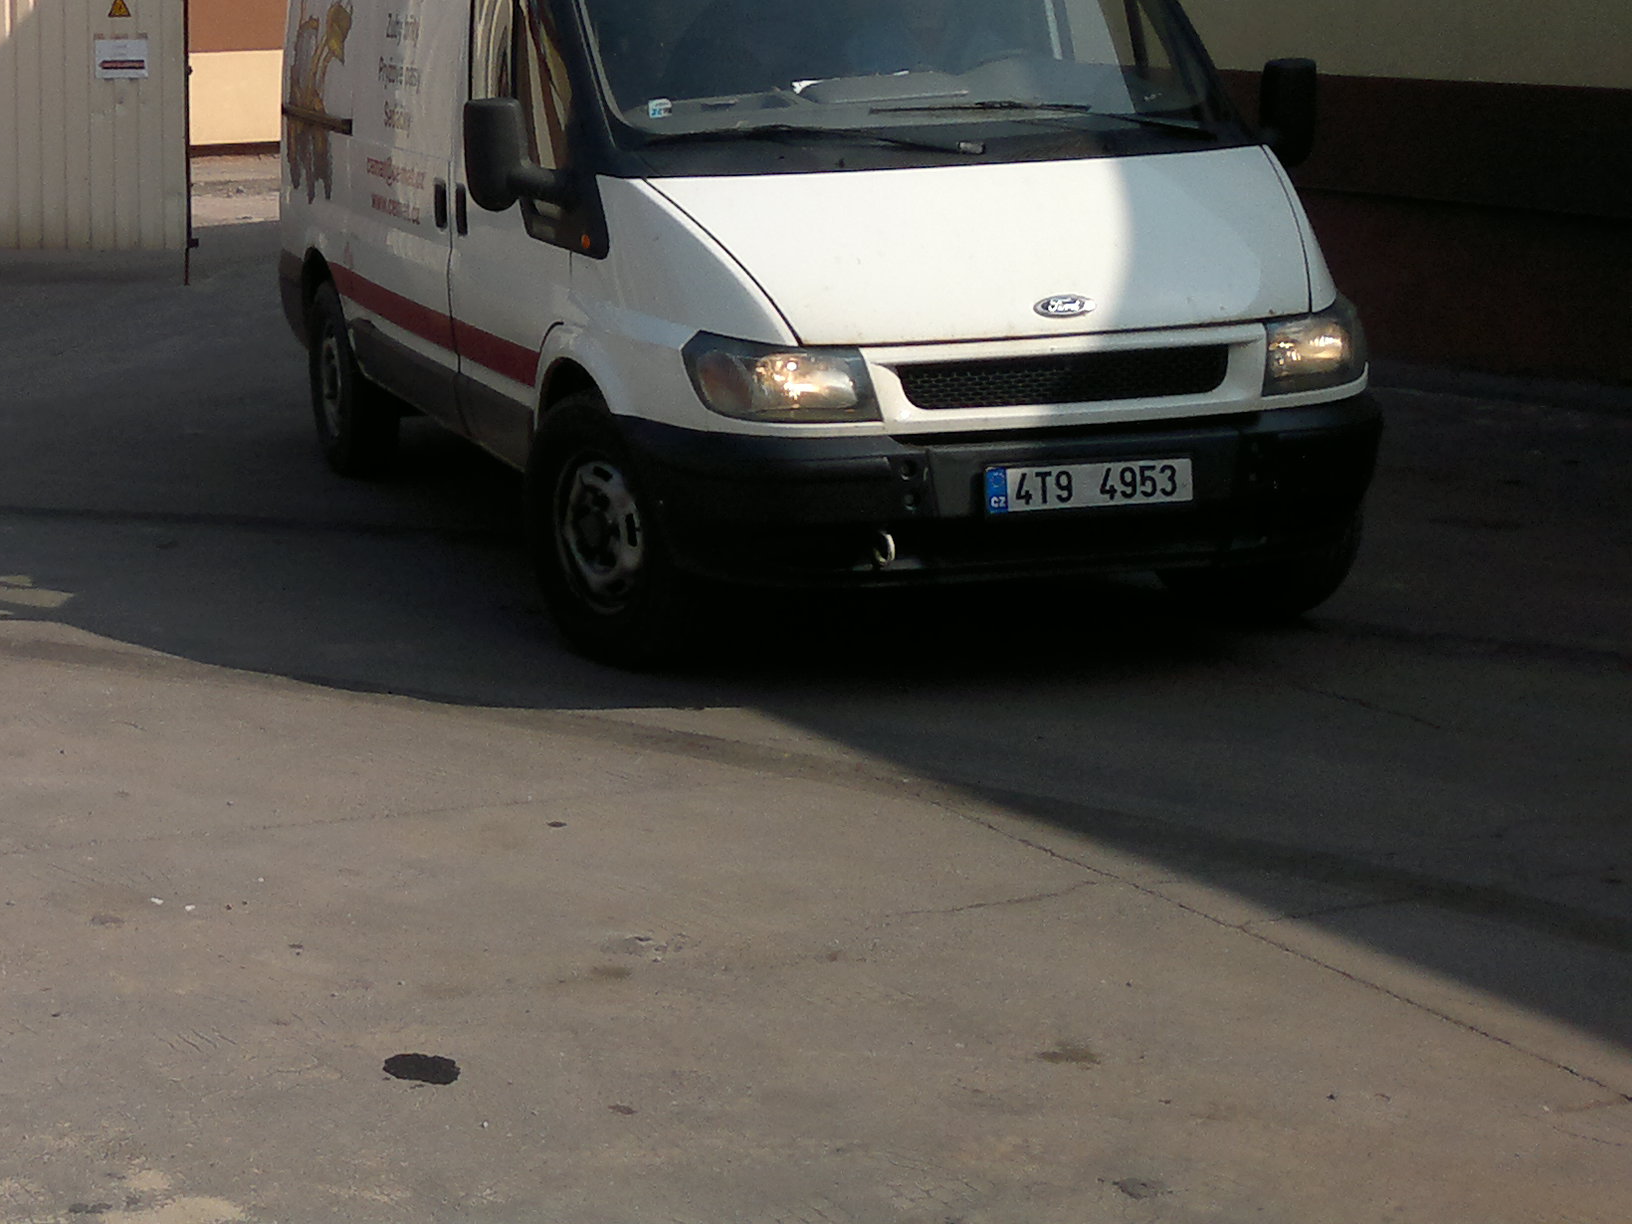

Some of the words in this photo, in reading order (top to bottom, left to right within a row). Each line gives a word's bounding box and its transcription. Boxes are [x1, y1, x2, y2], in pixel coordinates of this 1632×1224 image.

[1015, 471, 1074, 506] 4T9
[1099, 464, 1178, 502] 4953
[990, 496, 1008, 508] CZ
